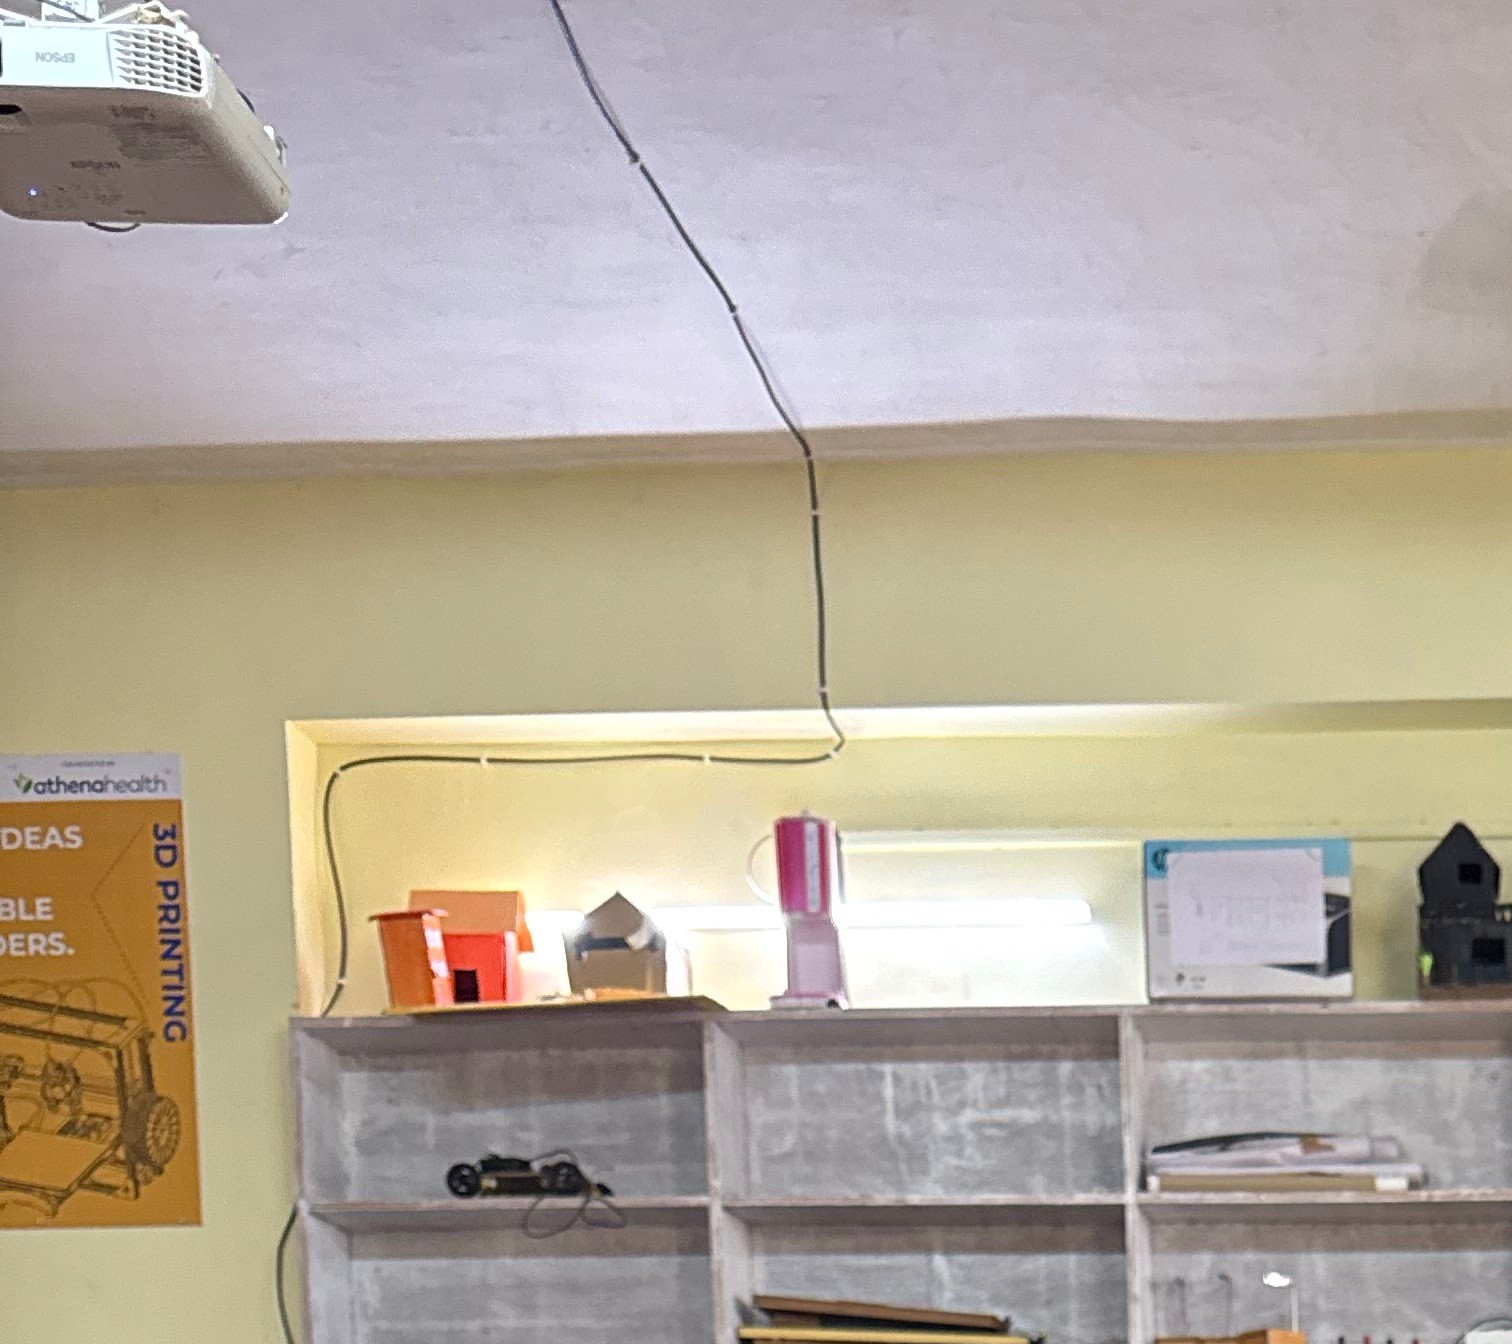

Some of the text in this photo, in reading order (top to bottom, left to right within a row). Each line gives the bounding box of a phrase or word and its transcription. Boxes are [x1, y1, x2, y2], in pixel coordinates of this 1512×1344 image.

[35, 51, 76, 64] EPSON
[33, 774, 168, 795] athenahealth
[153, 822, 189, 1043] 3D PRINTING
